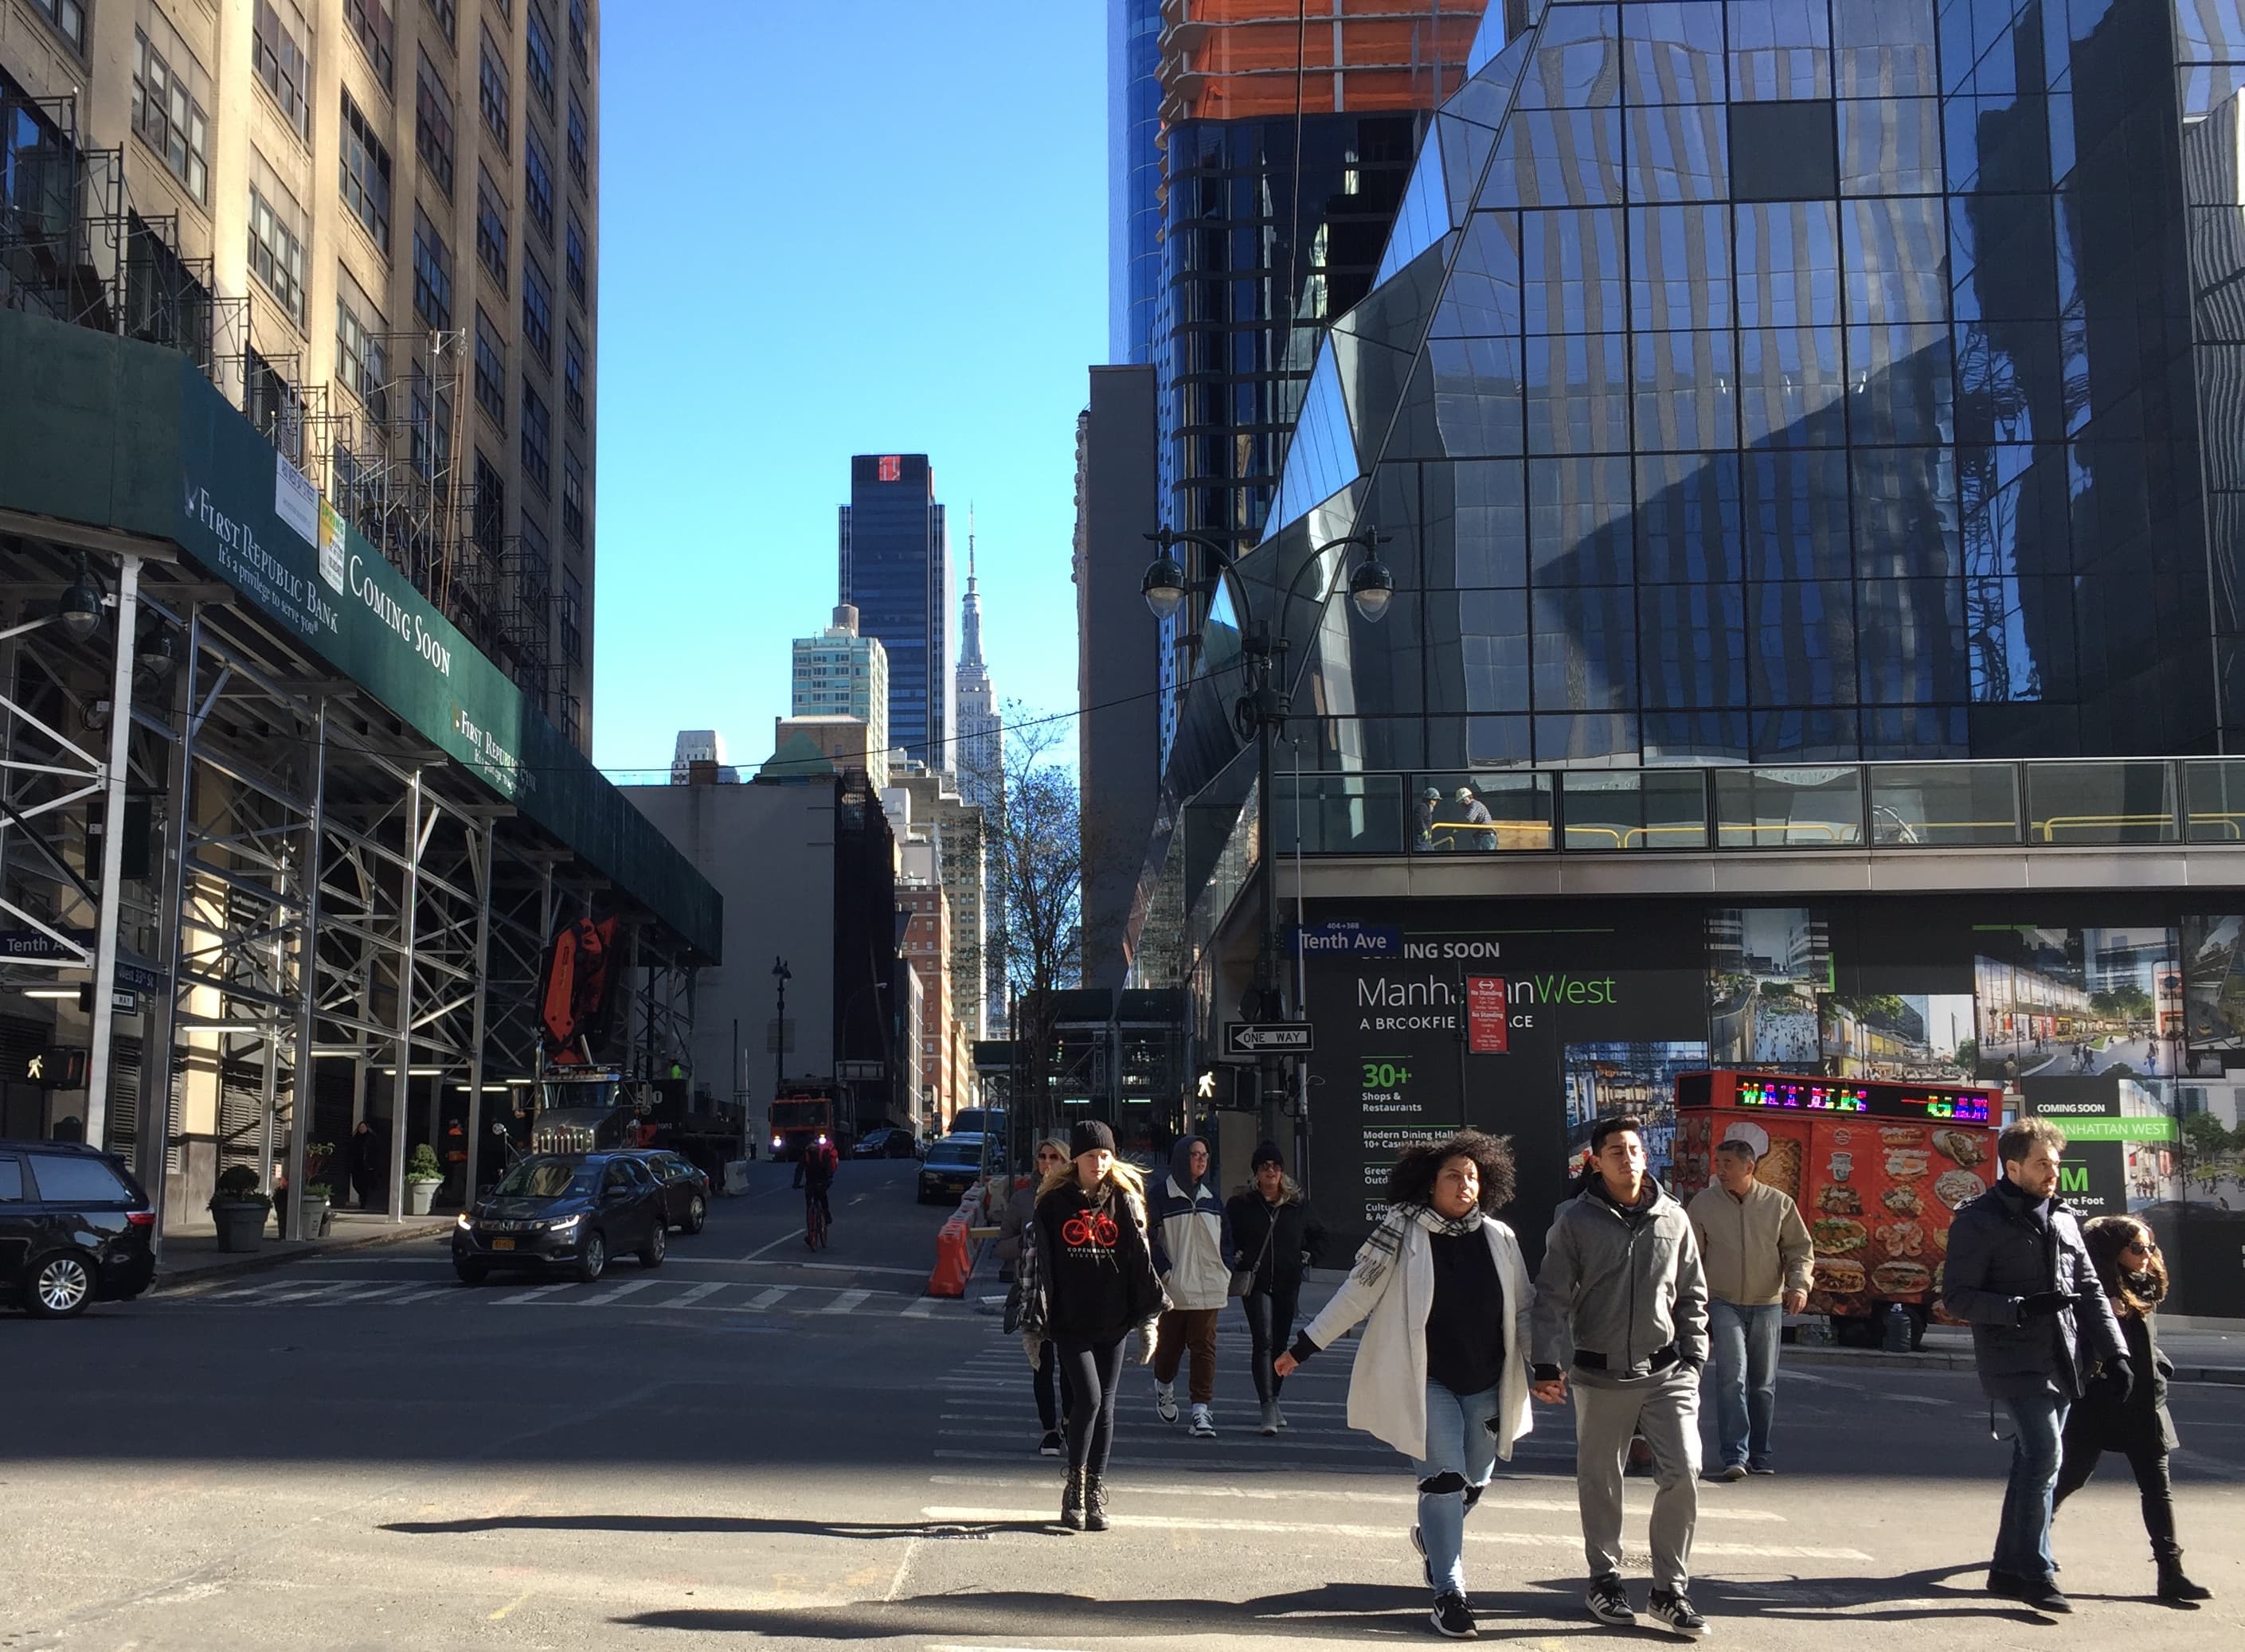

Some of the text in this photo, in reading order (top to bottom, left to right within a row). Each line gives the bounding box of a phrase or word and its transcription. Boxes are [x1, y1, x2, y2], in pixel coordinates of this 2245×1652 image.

[201, 487, 240, 549] FIRST
[242, 524, 303, 603] REPUBLIC
[307, 580, 338, 634] BANK
[218, 543, 231, 568] It's
[233, 560, 238, 573] a
[239, 566, 271, 603] privilege
[272, 591, 280, 607] to
[281, 600, 299, 623] serve
[350, 555, 410, 642] COMING
[415, 615, 451, 678] SOON
[461, 710, 483, 748] FIRST
[6, 936, 48, 952] Tenth
[1302, 933, 1387, 950] Tenth Ave
[1443, 942, 1500, 959] SOON
[1359, 1016, 1456, 1030] A BROOKFIE
[1243, 1032, 1300, 1043] ONE WAY
[1363, 1064, 1413, 1088] 30+
[1362, 1092, 1401, 1102] Shops &
[1363, 1103, 1422, 1112] Restaurants
[2037, 1103, 2106, 1113] COMING SOON
[1363, 1130, 1453, 1140] Modern Dining Hall
[2057, 1123, 2169, 1135] ANHATTAN WEST
[1364, 1176, 1388, 1185] Outd
[2061, 1167, 2089, 1192] M
[1365, 1203, 1390, 1212] Cultu
[2081, 1197, 2105, 1205] Foot
[1365, 1213, 1374, 1221] &
